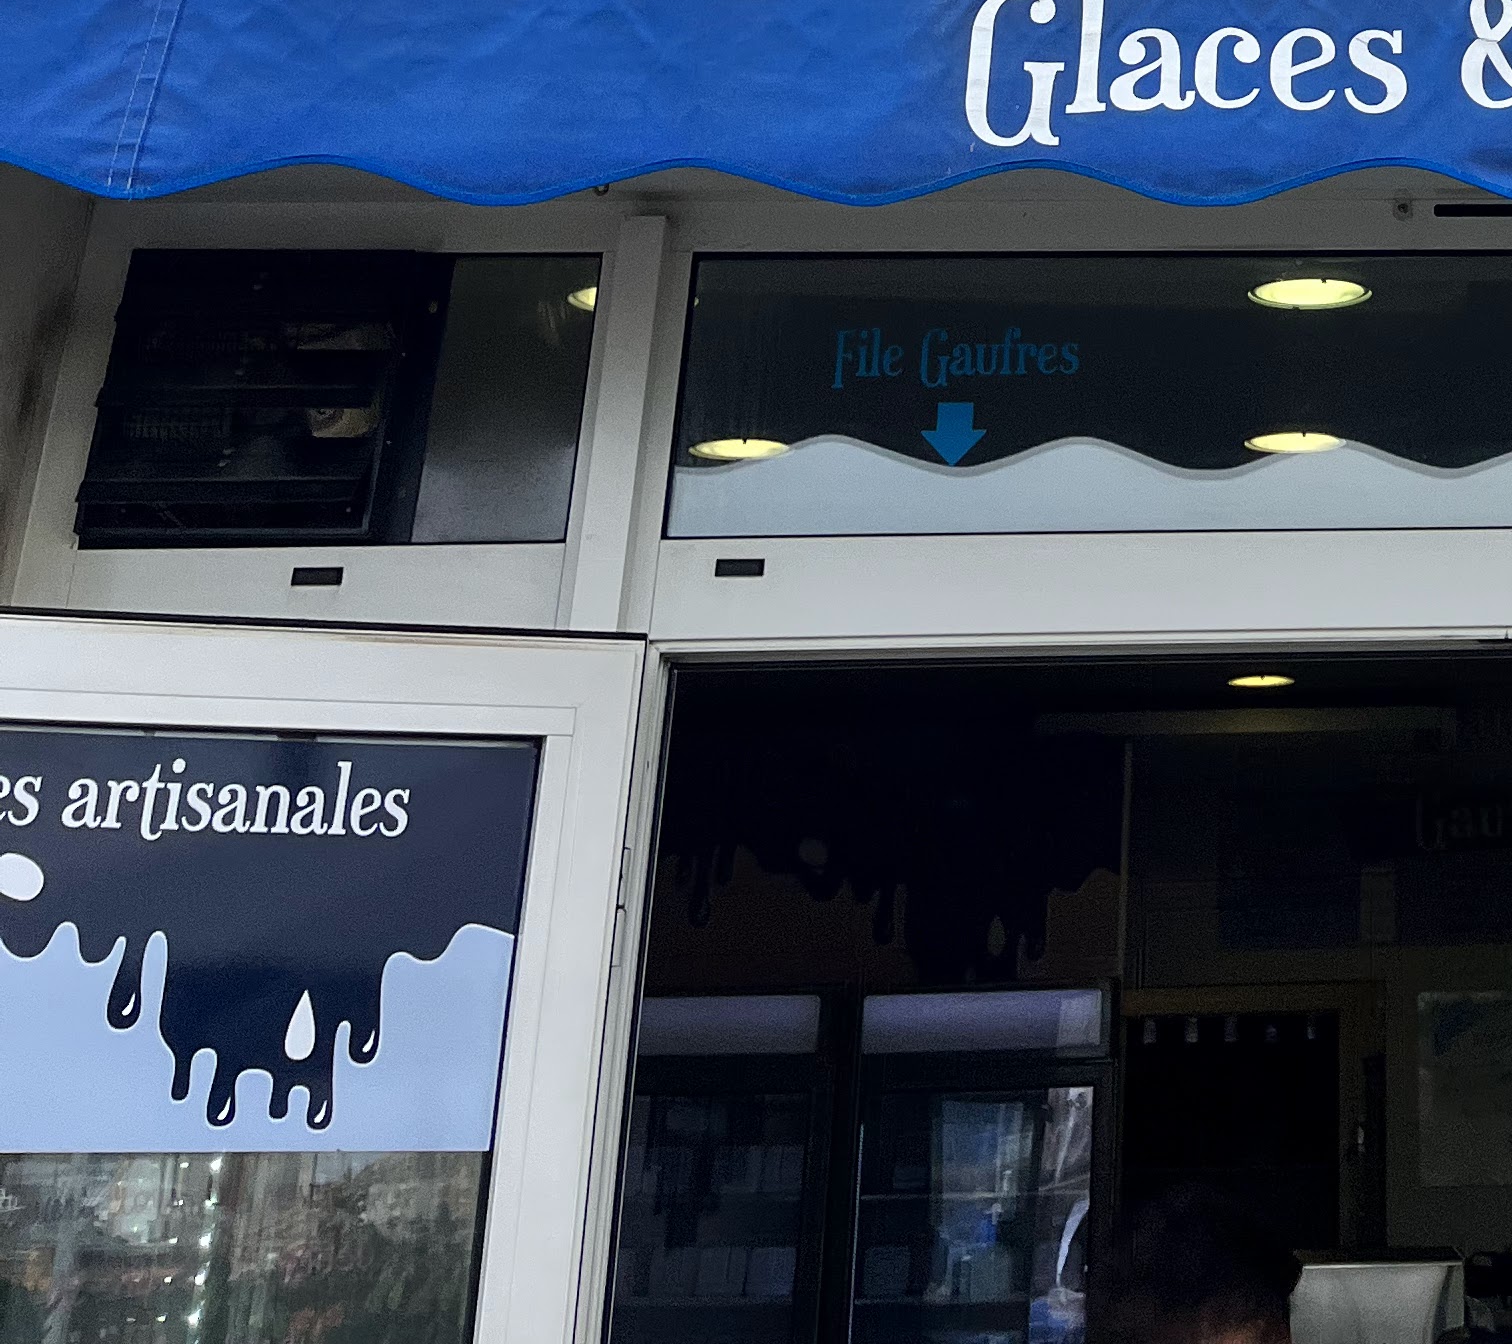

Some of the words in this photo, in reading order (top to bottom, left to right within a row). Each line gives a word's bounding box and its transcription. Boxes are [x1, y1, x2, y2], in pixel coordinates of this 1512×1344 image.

[831, 327, 904, 390] File
[919, 326, 1081, 389] Gaufres
[61, 758, 411, 841] artisanales
